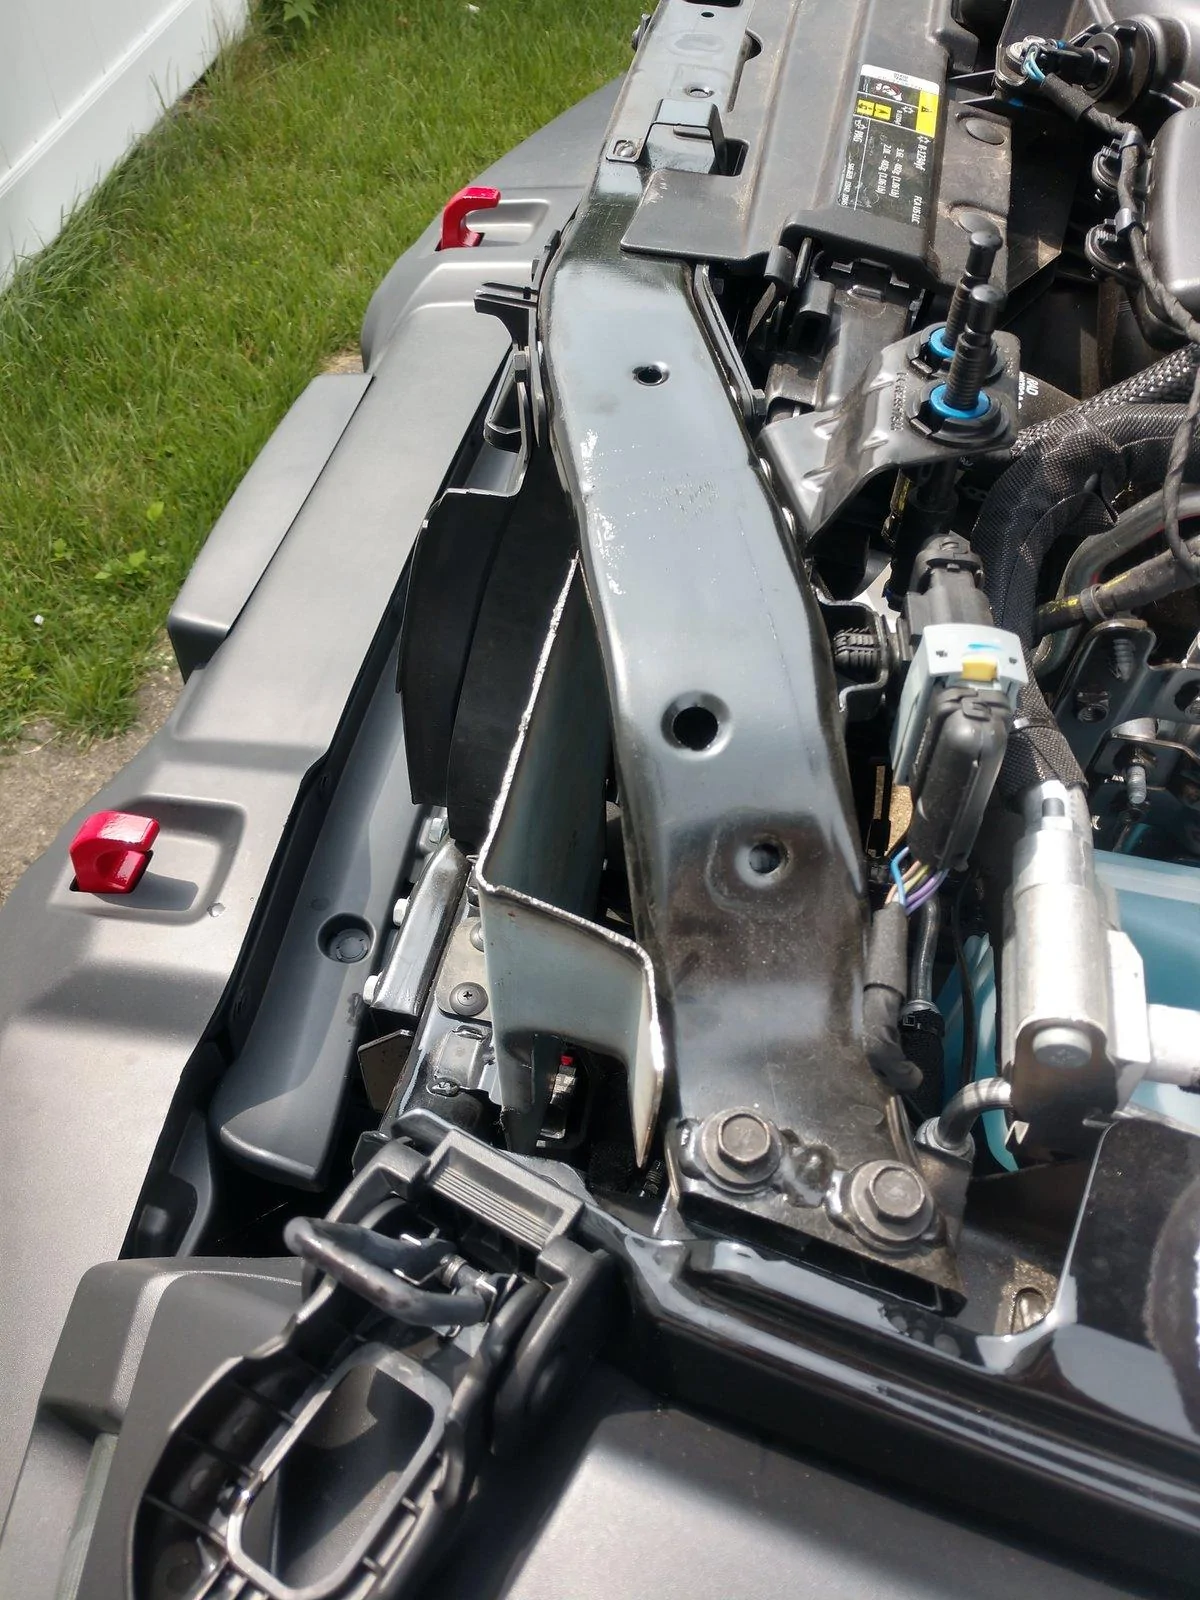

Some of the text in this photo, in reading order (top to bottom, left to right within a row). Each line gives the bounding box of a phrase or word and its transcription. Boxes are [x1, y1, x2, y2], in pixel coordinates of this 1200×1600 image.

[853, 129, 864, 143] PAG
[914, 195, 923, 206] FCA
[911, 213, 920, 225] LLC
[1026, 377, 1039, 396] RAD
